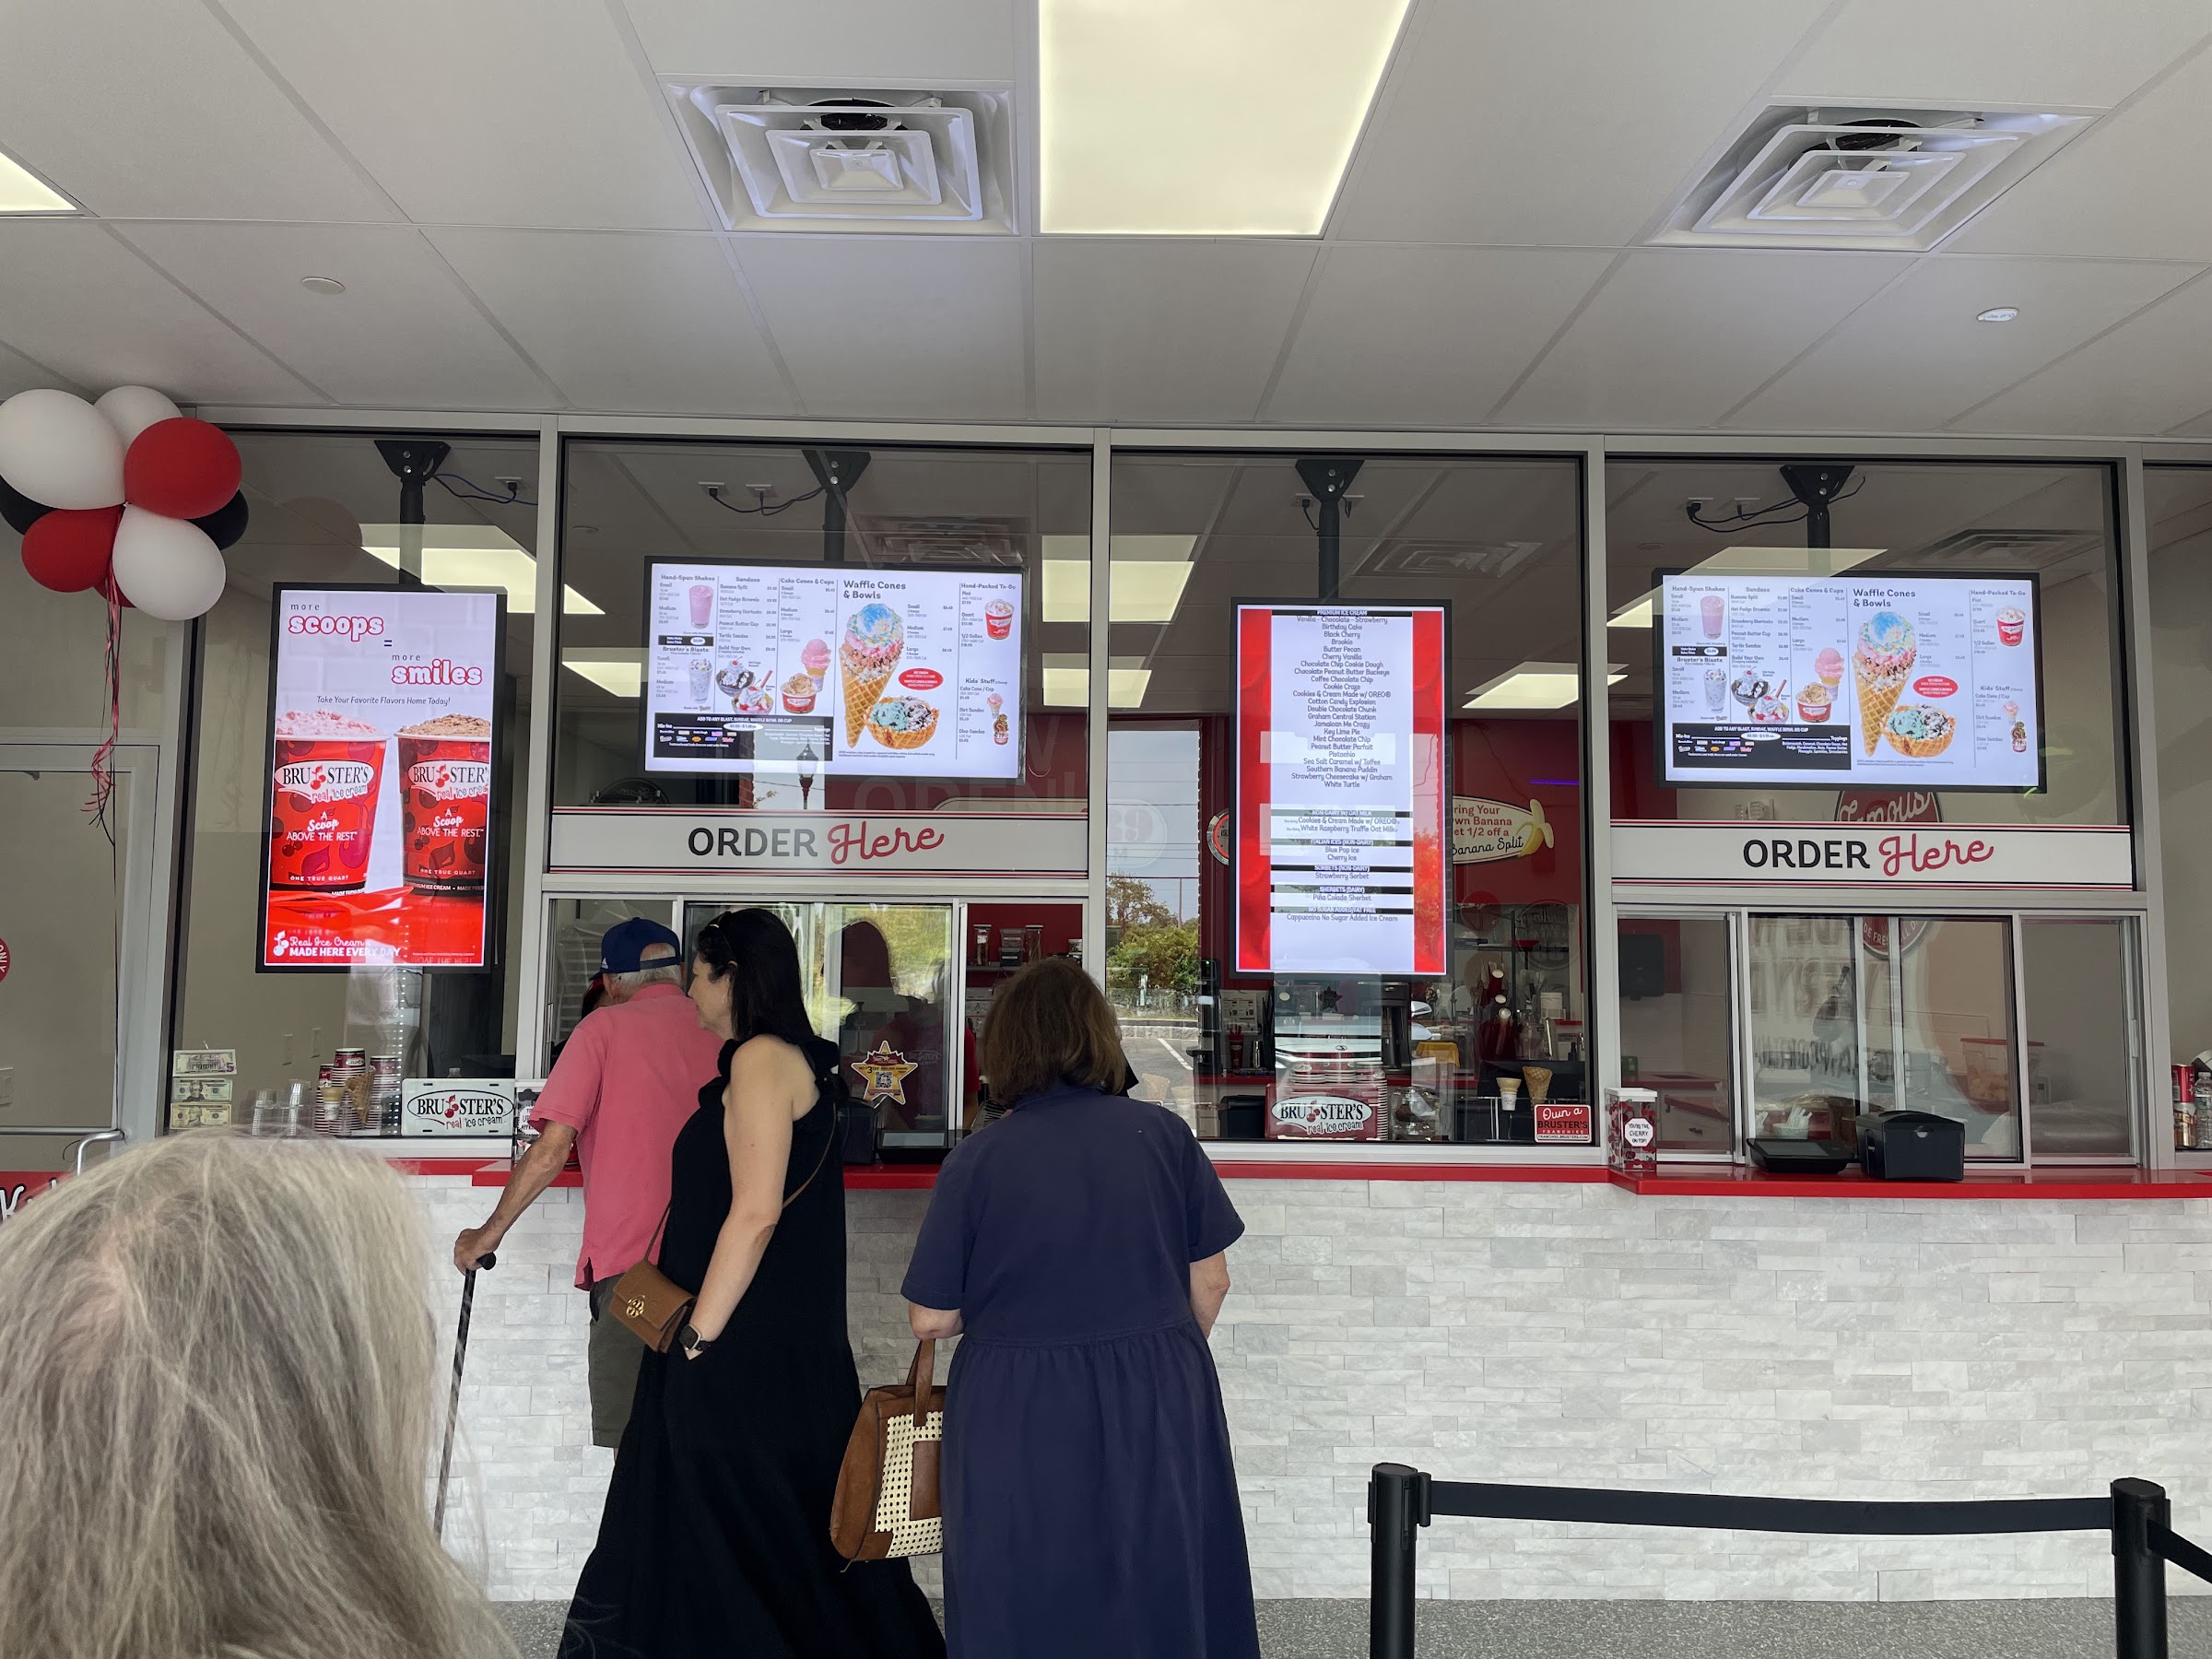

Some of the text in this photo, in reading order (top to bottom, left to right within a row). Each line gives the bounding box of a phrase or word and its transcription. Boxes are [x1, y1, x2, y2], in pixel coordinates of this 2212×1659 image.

[843, 581, 906, 590] Waffle Cones
[843, 591, 881, 599] & Bowls
[1853, 589, 1885, 597] Waffle
[288, 616, 383, 641] scoops
[392, 659, 483, 685] smiles
[429, 698, 451, 706] Today!
[413, 767, 489, 782] BRUSTER'
[312, 785, 366, 801] real ice cream
[437, 787, 466, 800] real ice
[321, 811, 327, 819] A
[445, 808, 452, 817] A
[1454, 805, 1500, 817] ring Your
[308, 819, 339, 831] Scoop
[433, 817, 464, 827] Scoop
[1474, 817, 1512, 825] Banana
[418, 828, 441, 836] ABOVE
[442, 829, 458, 837] THE
[1320, 825, 1349, 833] Raspberry
[1454, 828, 1464, 836] et
[1467, 828, 1484, 838] 1/2
[1488, 828, 1500, 836] off
[287, 832, 314, 841] ABOVE
[318, 832, 333, 841] THE
[688, 821, 944, 865] ORDER Here
[1453, 835, 1524, 855] Banana Split
[1743, 833, 1994, 877] ORDER Here
[290, 936, 365, 947] Real Ice Cream
[347, 948, 378, 957] EVERY
[381, 948, 401, 957] DAY
[1543, 1108, 1571, 1120] Own
[446, 1116, 502, 1129] real ice cream
[1308, 1122, 1362, 1133] real ice cream
